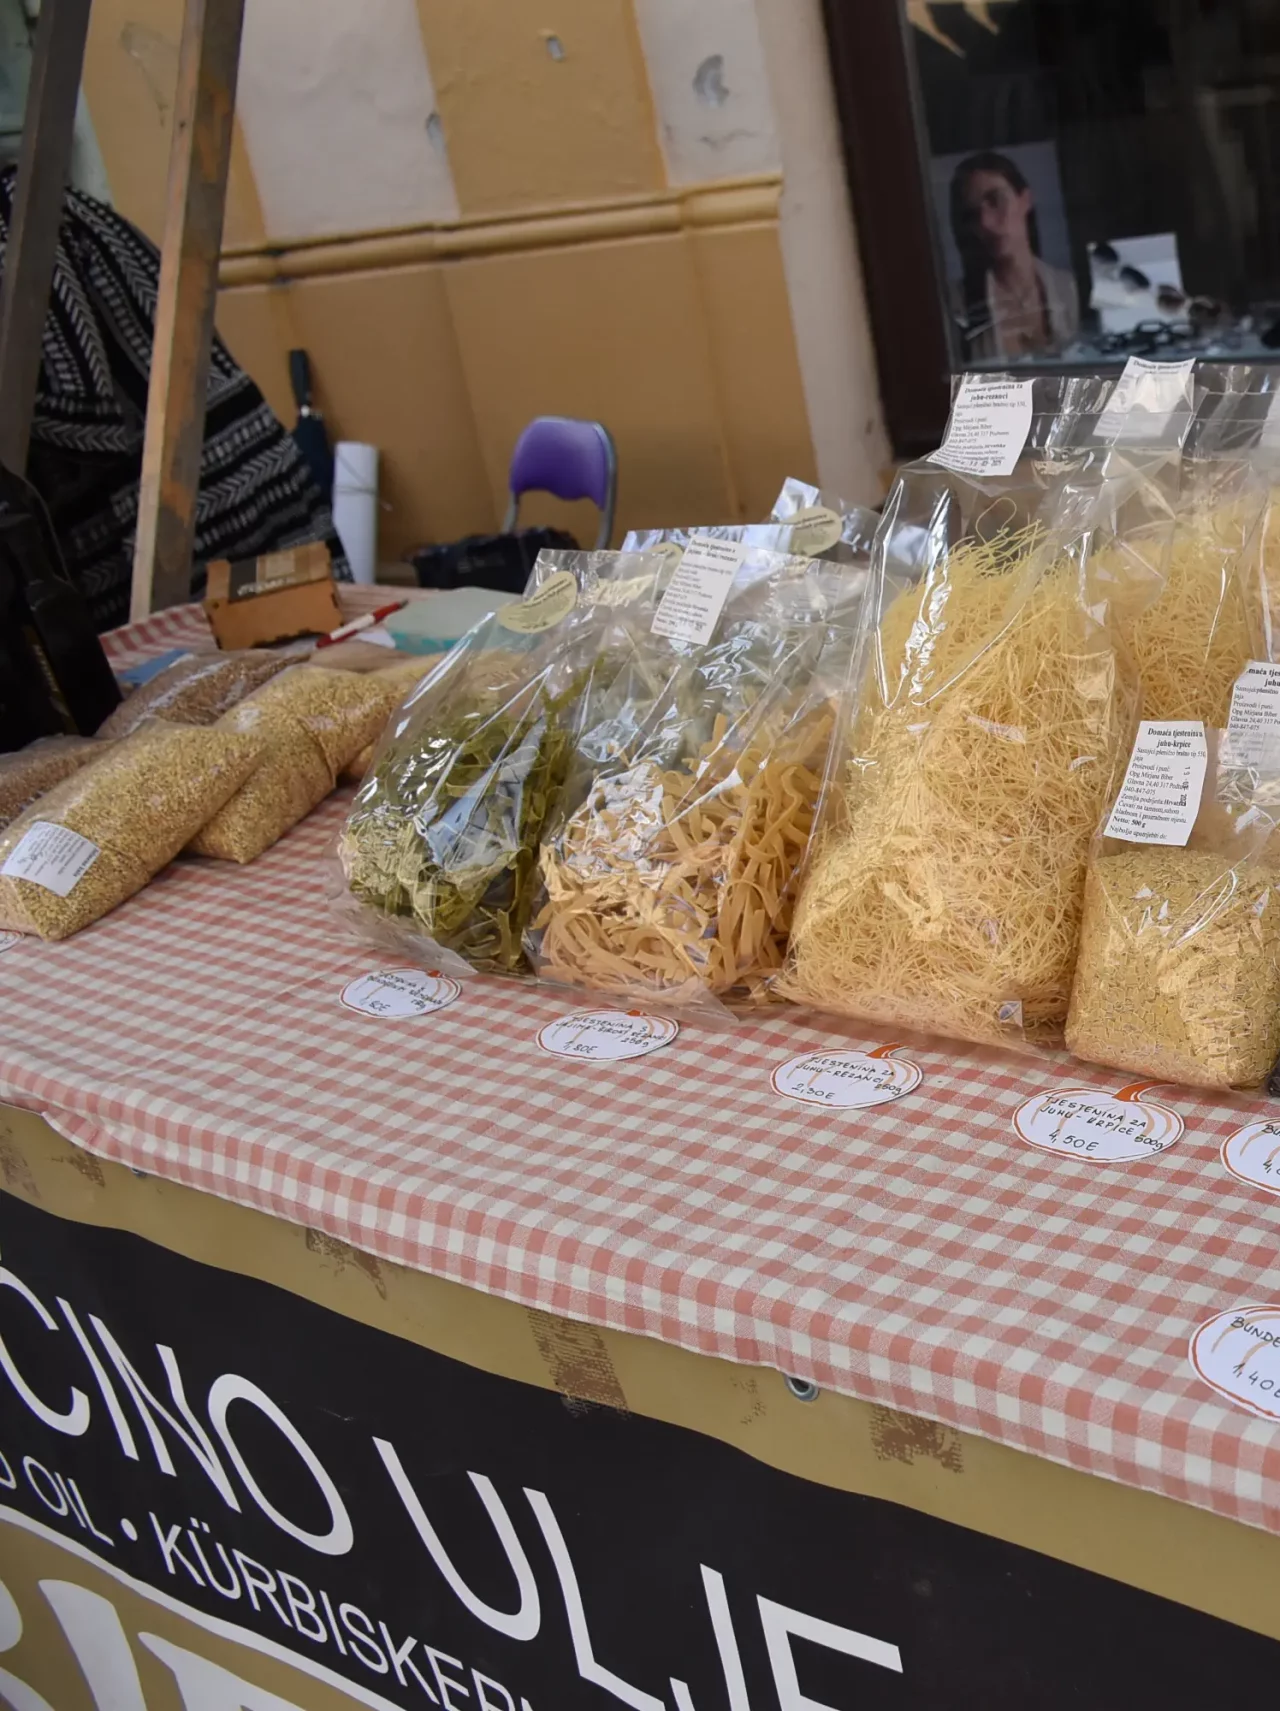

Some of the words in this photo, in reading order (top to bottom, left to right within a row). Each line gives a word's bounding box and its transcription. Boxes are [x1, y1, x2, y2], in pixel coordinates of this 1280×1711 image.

[1148, 728, 1171, 736] Domaća
[1157, 740, 1191, 749] juhu-krpice
[1129, 771, 1141, 779] Opg
[1141, 772, 1159, 781] Mirjana
[1127, 778, 1144, 786] Glavna
[1124, 786, 1156, 795] 040-847-075
[1113, 816, 1130, 824] Netto:
[810, 1056, 876, 1073] TJESTENINA
[1045, 1095, 1123, 1122] TJESTENINA
[1040, 1106, 1073, 1119] JUHU
[1086, 1117, 1135, 1136] KRPICE
[1134, 1134, 1164, 1151] 500g
[23, 1455, 115, 1547] OIL
[149, 1511, 534, 1711] KÜRBISKER
